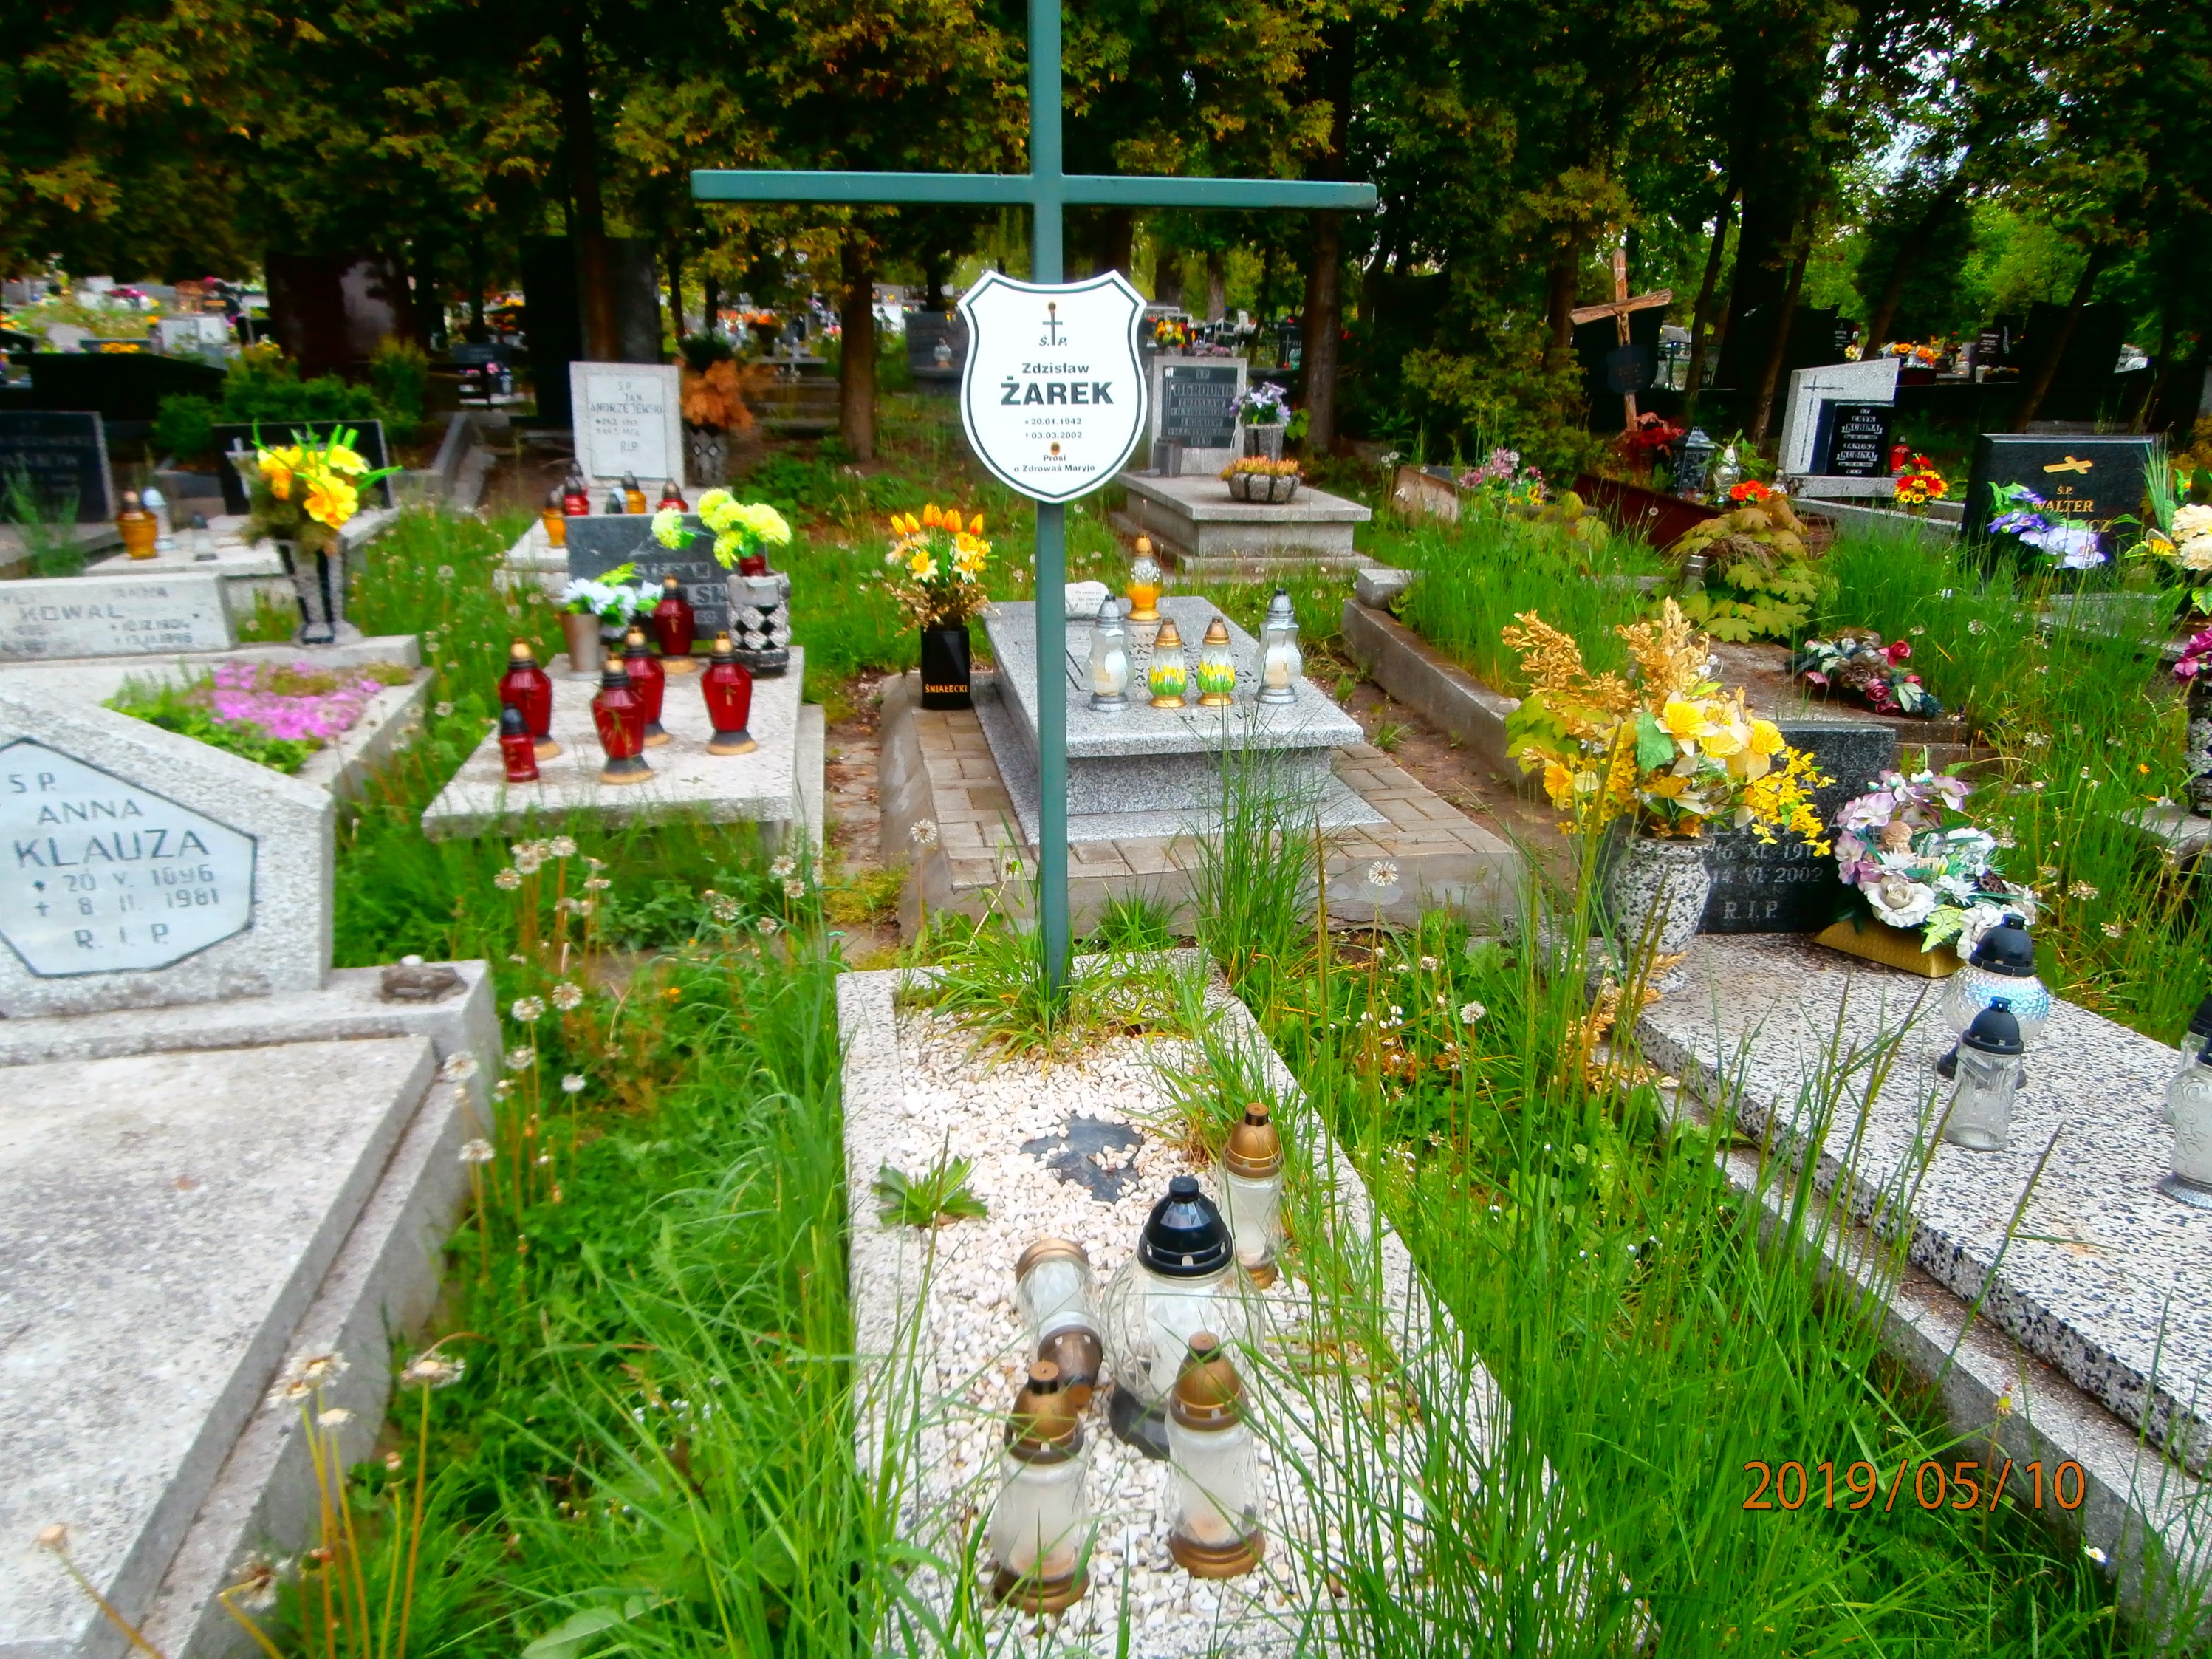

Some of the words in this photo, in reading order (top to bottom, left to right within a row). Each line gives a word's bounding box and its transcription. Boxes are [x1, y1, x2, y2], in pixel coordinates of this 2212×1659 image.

[1021, 362, 1089, 374] Zdzisław
[1000, 375, 1114, 406] ŻAREK
[1173, 383, 1237, 397] OGRODNIK
[623, 393, 643, 401] JAN
[590, 402, 666, 414] ANDRZEJEWSKI
[1846, 423, 1880, 431] KUBINA
[1043, 454, 1066, 462] Prosi
[1840, 451, 1875, 459] KUBINA
[1022, 464, 1062, 472] Zdrowaś
[1064, 464, 1095, 473] Maryjo
[2033, 500, 2095, 512] WALTER
[19, 603, 124, 620] KOWAL
[38, 798, 143, 825] ANNA
[13, 828, 210, 869] KLAUZA
[1773, 866, 1824, 883] 2002
[164, 887, 220, 909] 1981
